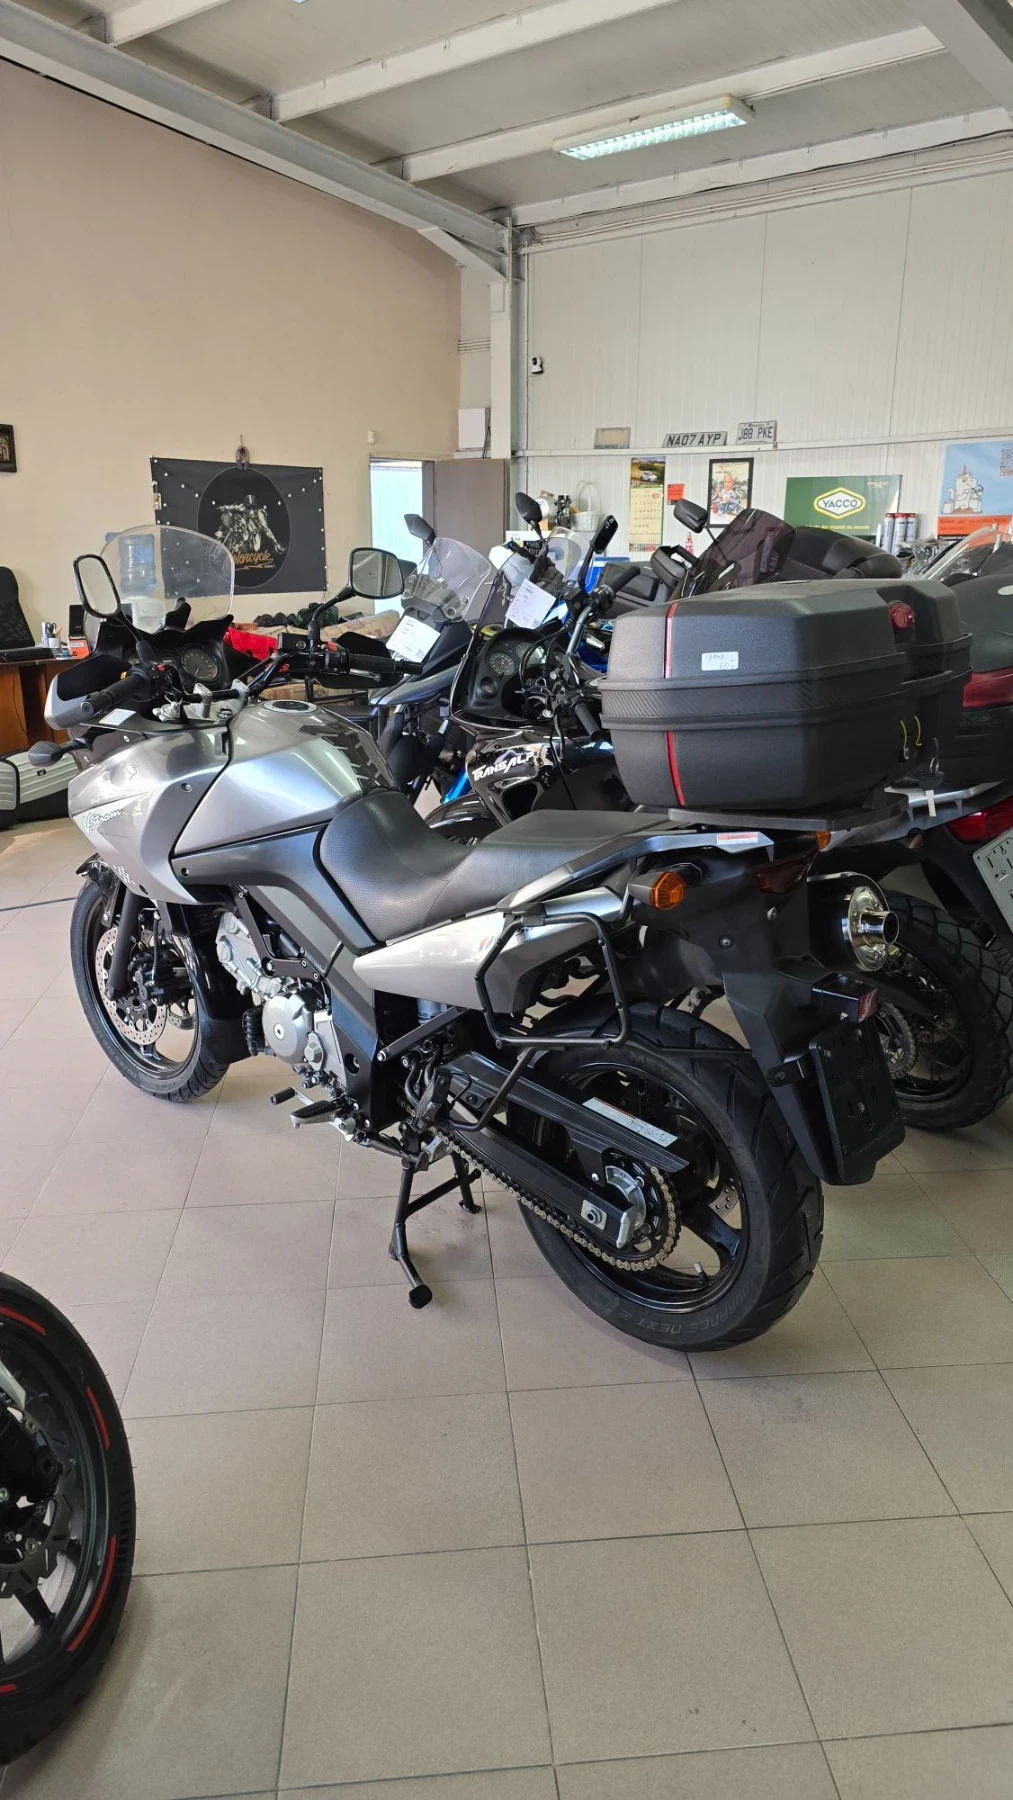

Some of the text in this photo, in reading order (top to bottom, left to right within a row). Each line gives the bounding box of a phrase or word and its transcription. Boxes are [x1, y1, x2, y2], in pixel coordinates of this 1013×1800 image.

[757, 426, 774, 439] PKE
[697, 433, 722, 446] AYP
[822, 499, 858, 508] YACCO
[472, 752, 534, 781] TRANSALP
